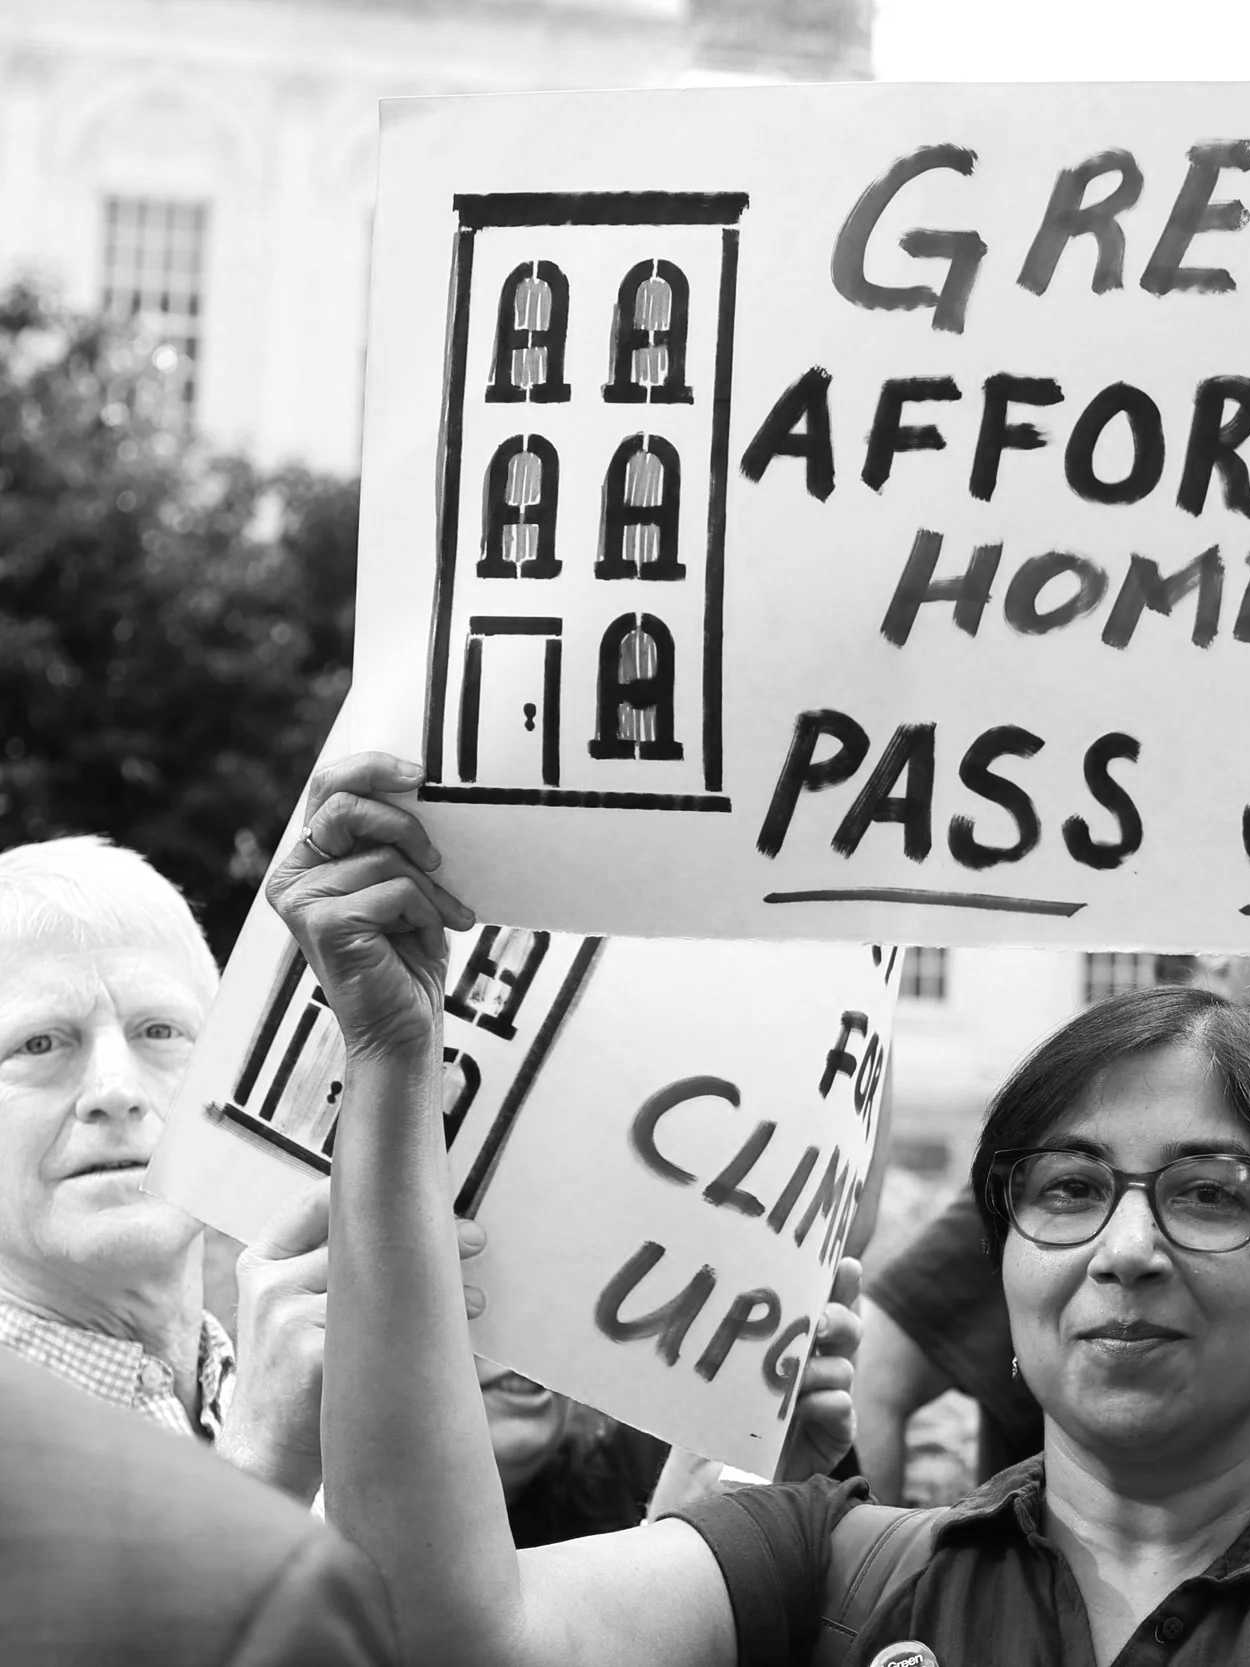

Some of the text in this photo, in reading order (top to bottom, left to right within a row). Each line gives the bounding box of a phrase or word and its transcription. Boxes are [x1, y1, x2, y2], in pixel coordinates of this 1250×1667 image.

[756, 708, 1144, 871] PASS
[818, 1010, 884, 1142] FOR
[629, 1075, 863, 1277] CLIMA
